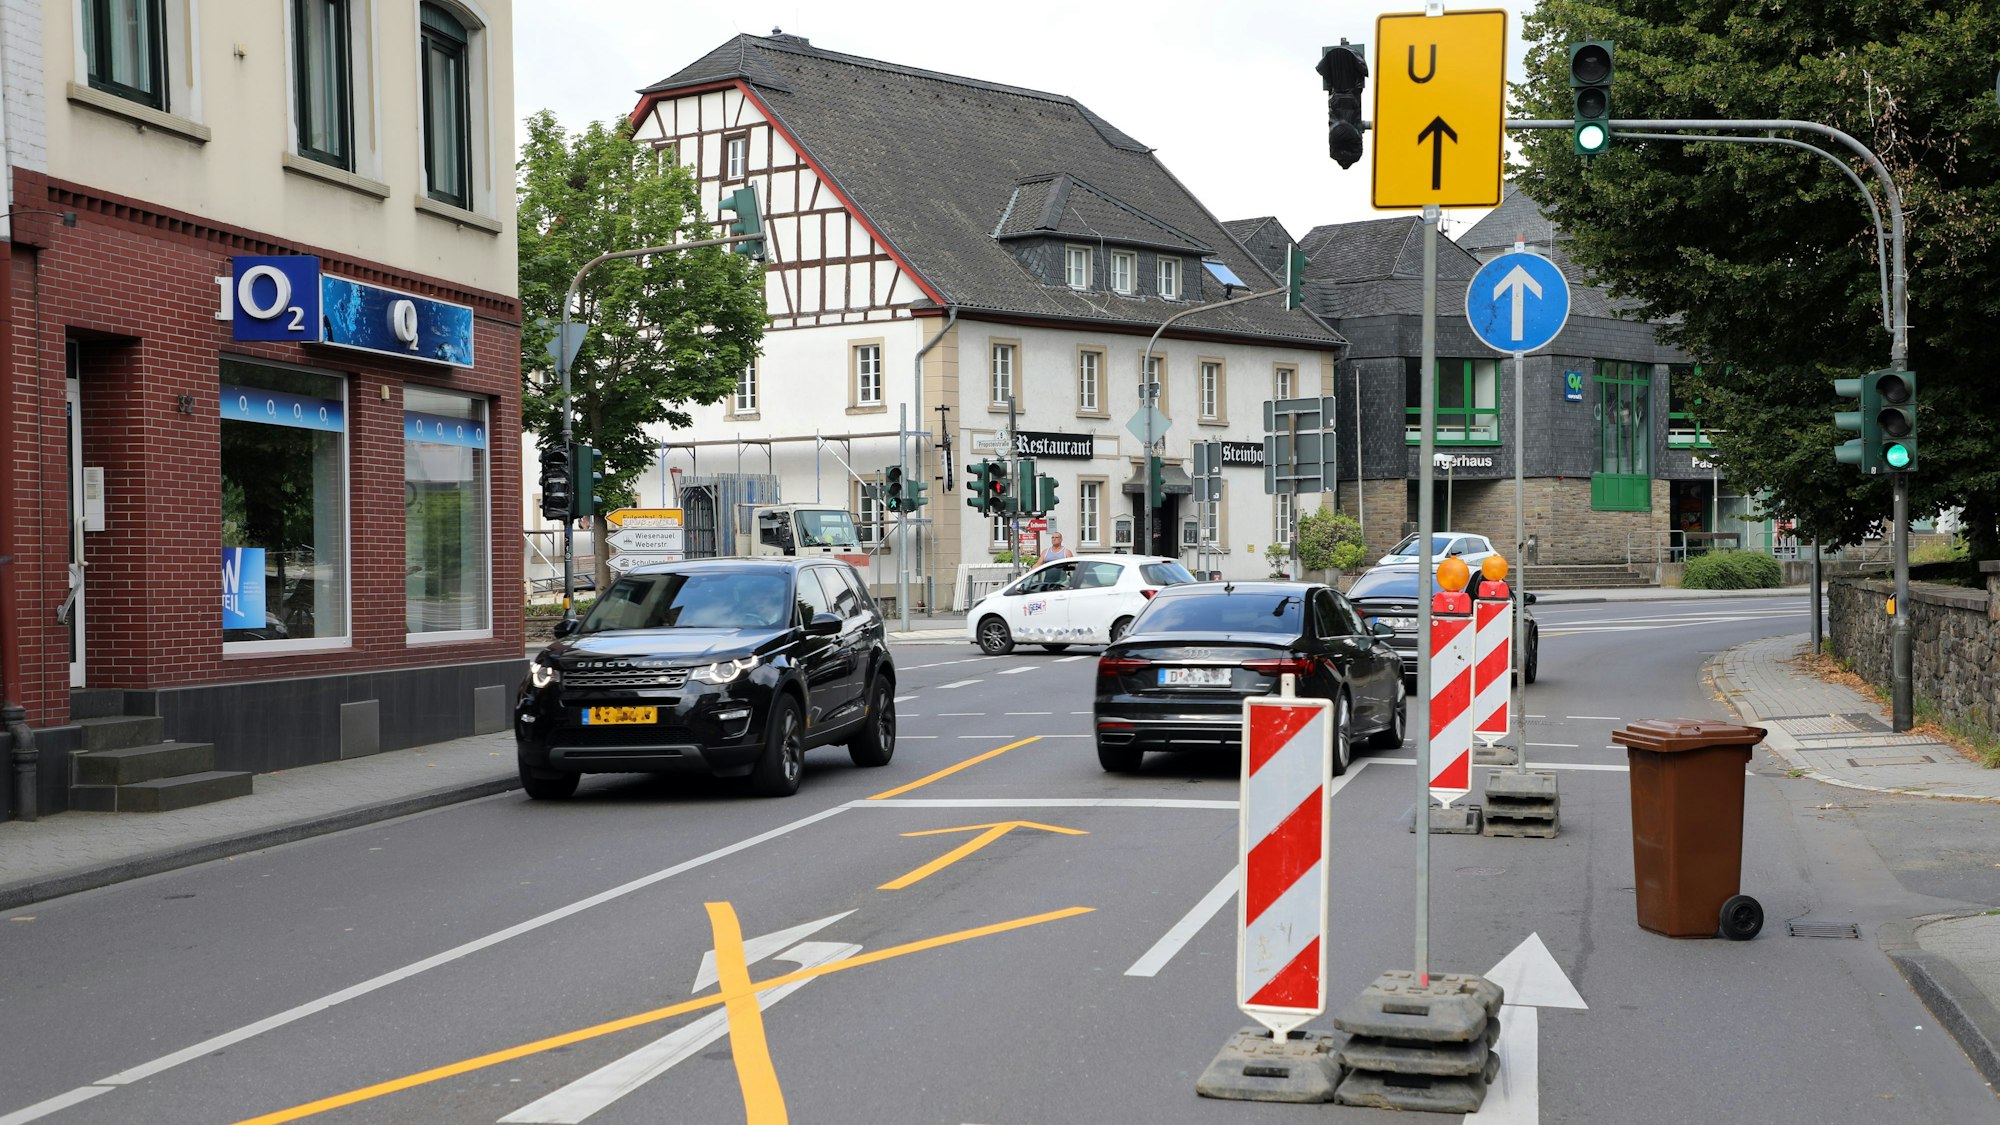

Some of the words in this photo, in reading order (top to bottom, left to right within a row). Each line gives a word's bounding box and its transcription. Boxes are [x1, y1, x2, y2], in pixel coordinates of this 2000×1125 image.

[1407, 43, 1437, 84] U
[1016, 434, 1092, 456] Restaurant
[1420, 454, 1493, 470] rgerhaus
[576, 660, 675, 668] DISCOVERY
